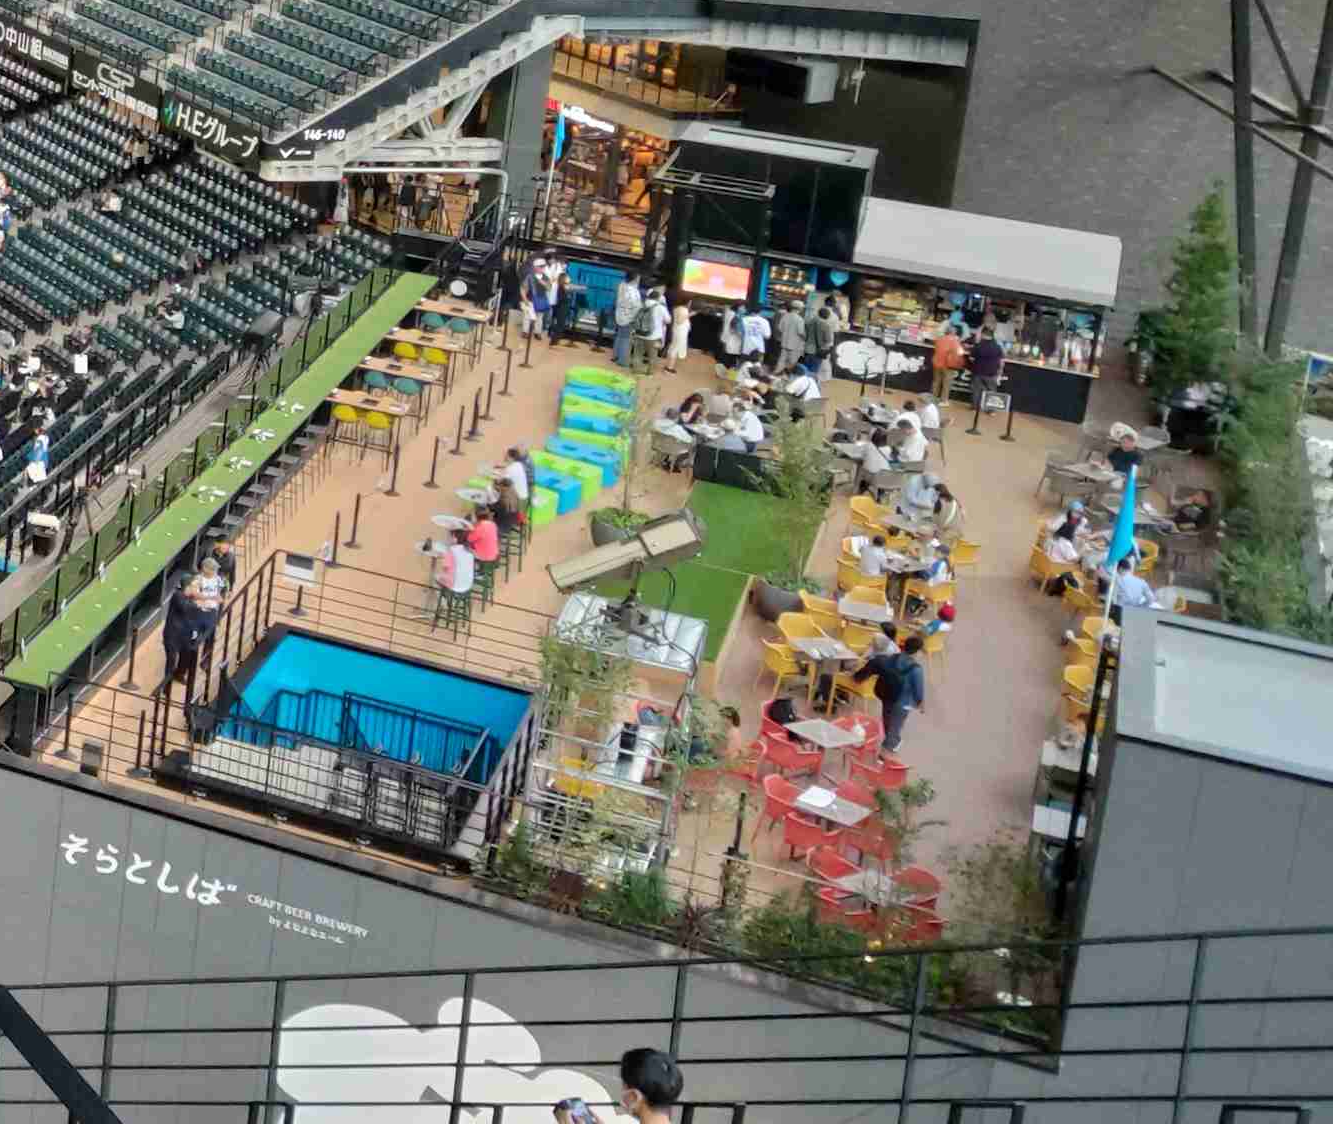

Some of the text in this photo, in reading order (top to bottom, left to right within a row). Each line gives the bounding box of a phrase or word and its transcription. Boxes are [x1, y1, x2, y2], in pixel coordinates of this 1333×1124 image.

[96, 61, 135, 91] CSP
[60, 833, 239, 906] そらとしば
[246, 891, 370, 939] CRAFT BEER BREWERY
